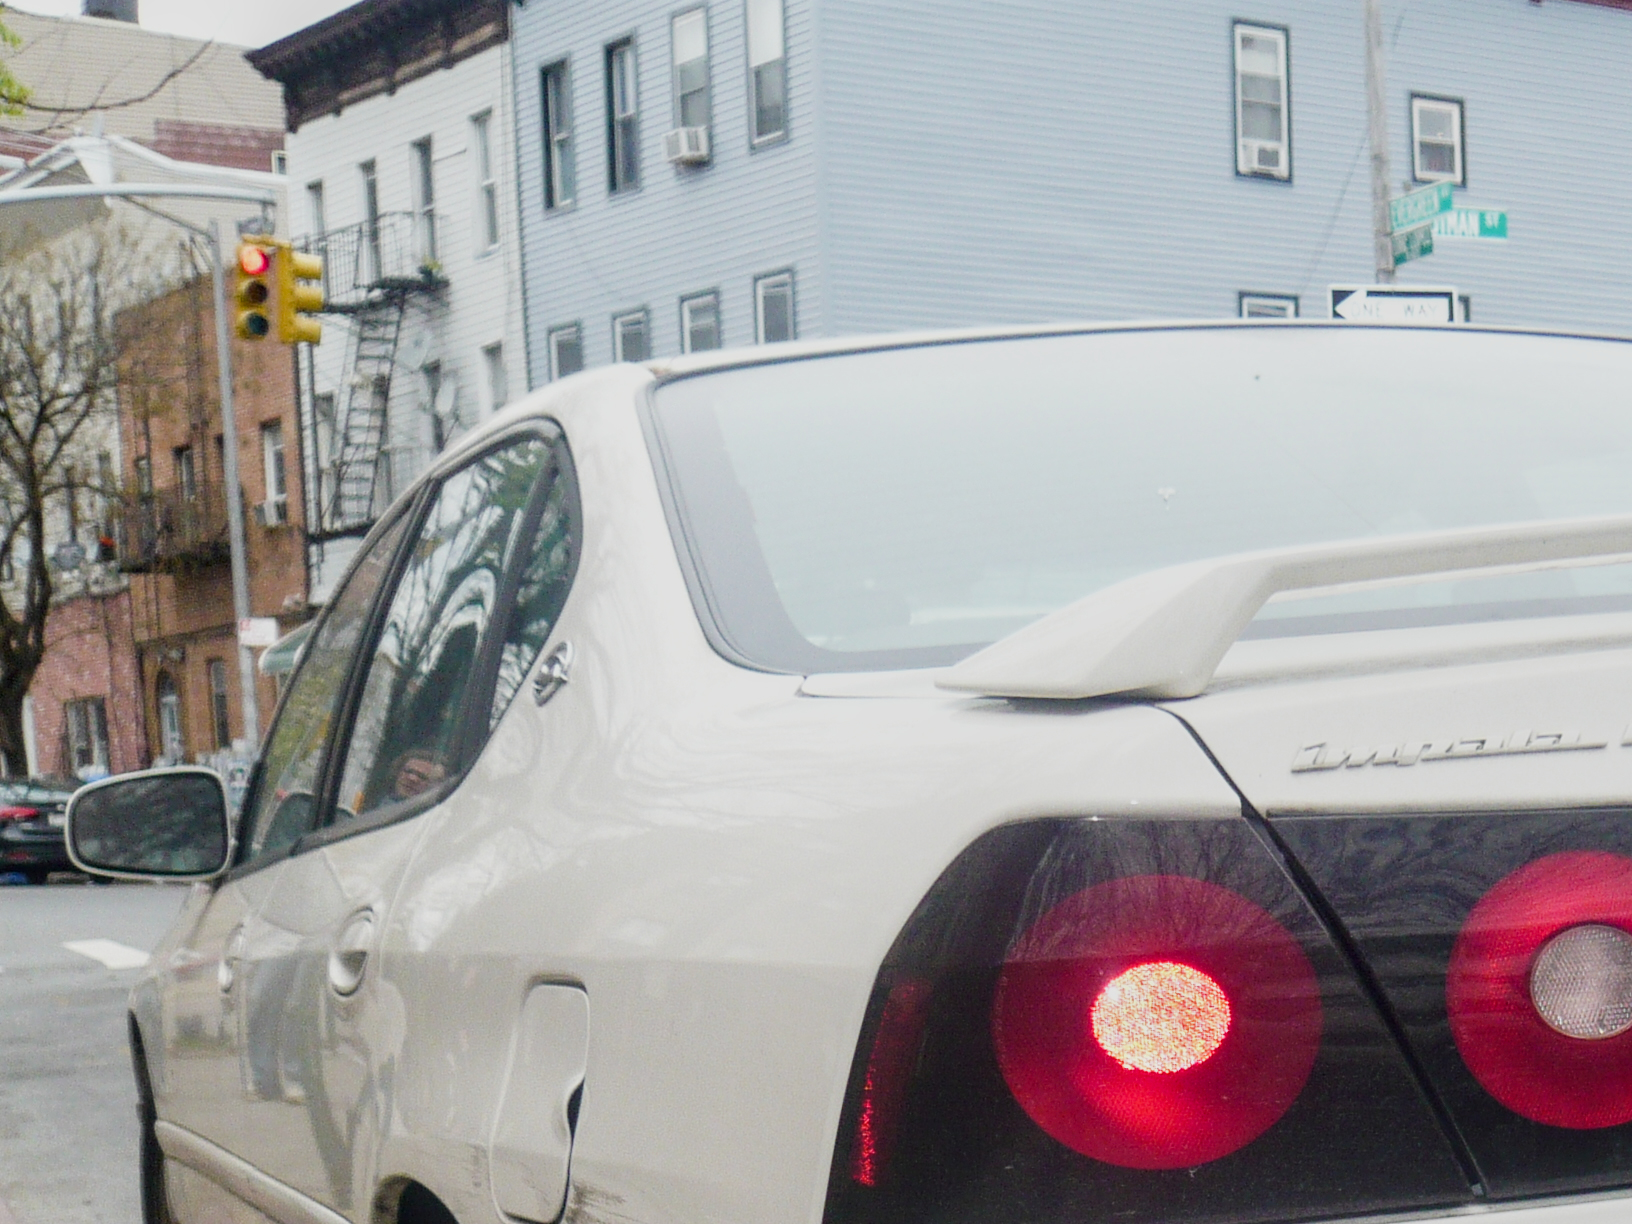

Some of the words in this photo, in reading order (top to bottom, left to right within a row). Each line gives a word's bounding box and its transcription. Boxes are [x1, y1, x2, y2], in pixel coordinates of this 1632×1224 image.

[1484, 211, 1501, 229] ST
[1350, 302, 1383, 318] ONE
[1403, 303, 1437, 318] WAY
[1291, 729, 1607, 774] Impala
